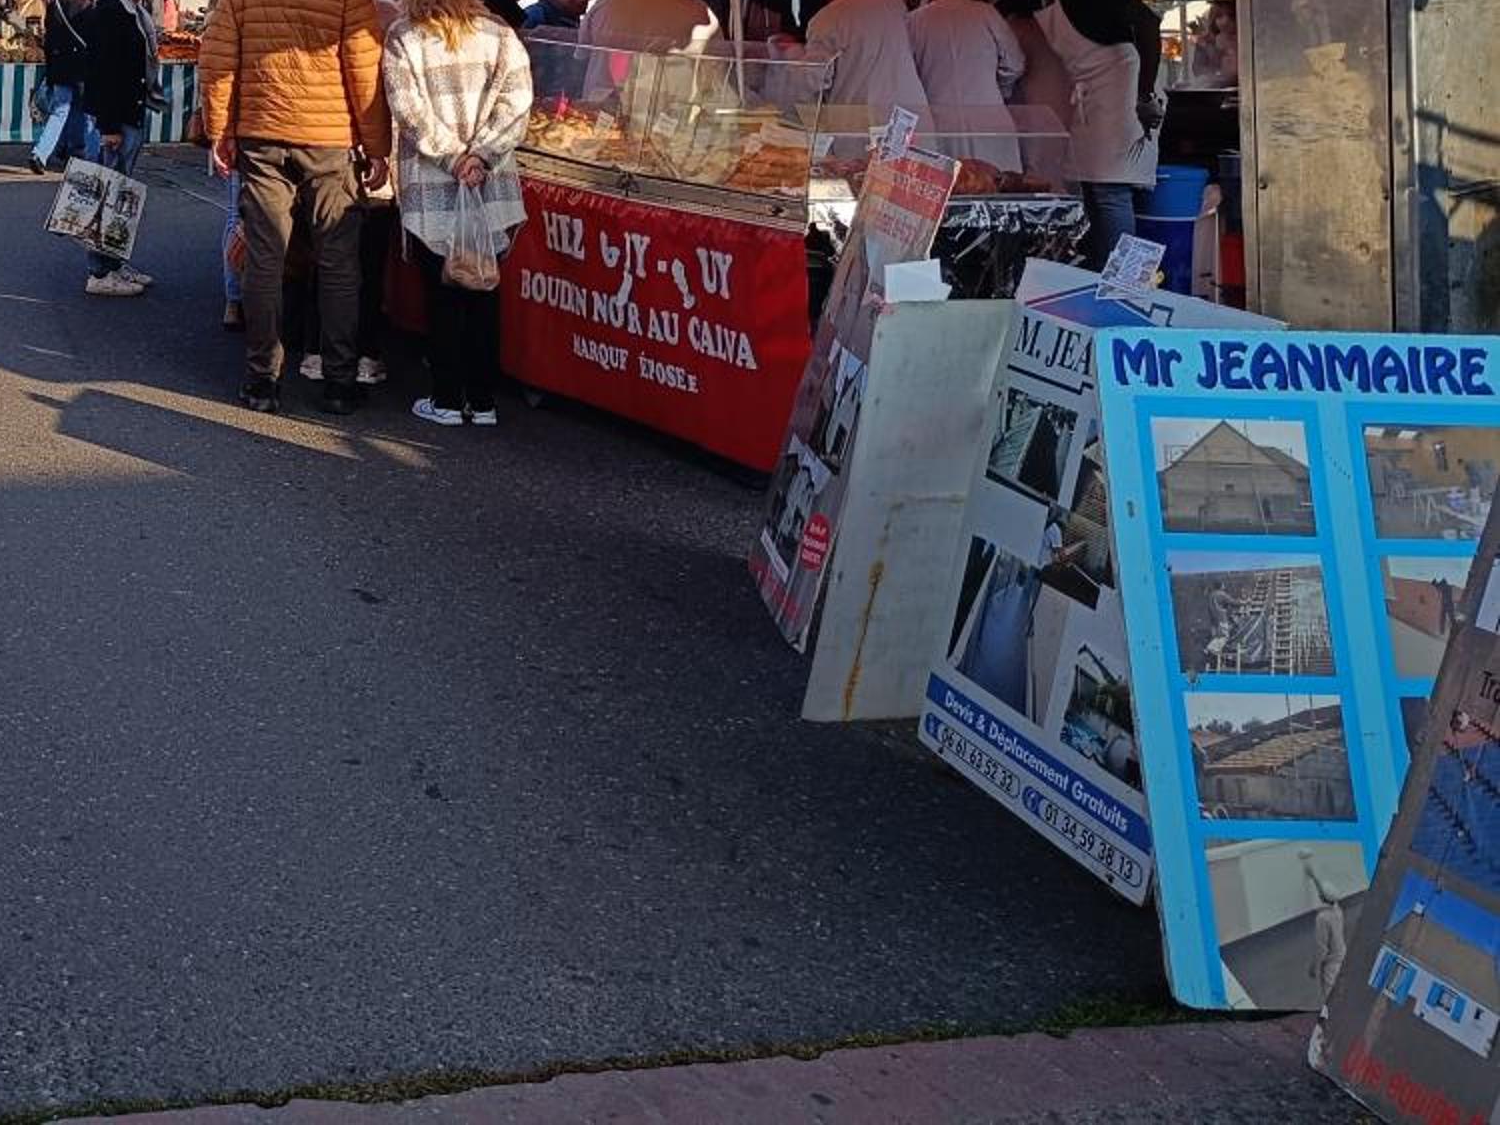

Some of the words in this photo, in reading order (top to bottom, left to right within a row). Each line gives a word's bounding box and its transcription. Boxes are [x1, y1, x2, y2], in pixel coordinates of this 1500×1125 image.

[647, 307, 680, 346] AU
[687, 315, 758, 370] CALVA
[1014, 316, 1041, 360] M.
[1111, 338, 1183, 388] Mr
[1197, 340, 1495, 396] JEANMAIRE
[944, 690, 975, 724] Devis
[976, 714, 986, 733] &
[988, 720, 1069, 790] Déplacement
[1071, 780, 1129, 834] Gratuits
[1080, 829, 1096, 852] 59
[1119, 856, 1133, 880] 13
